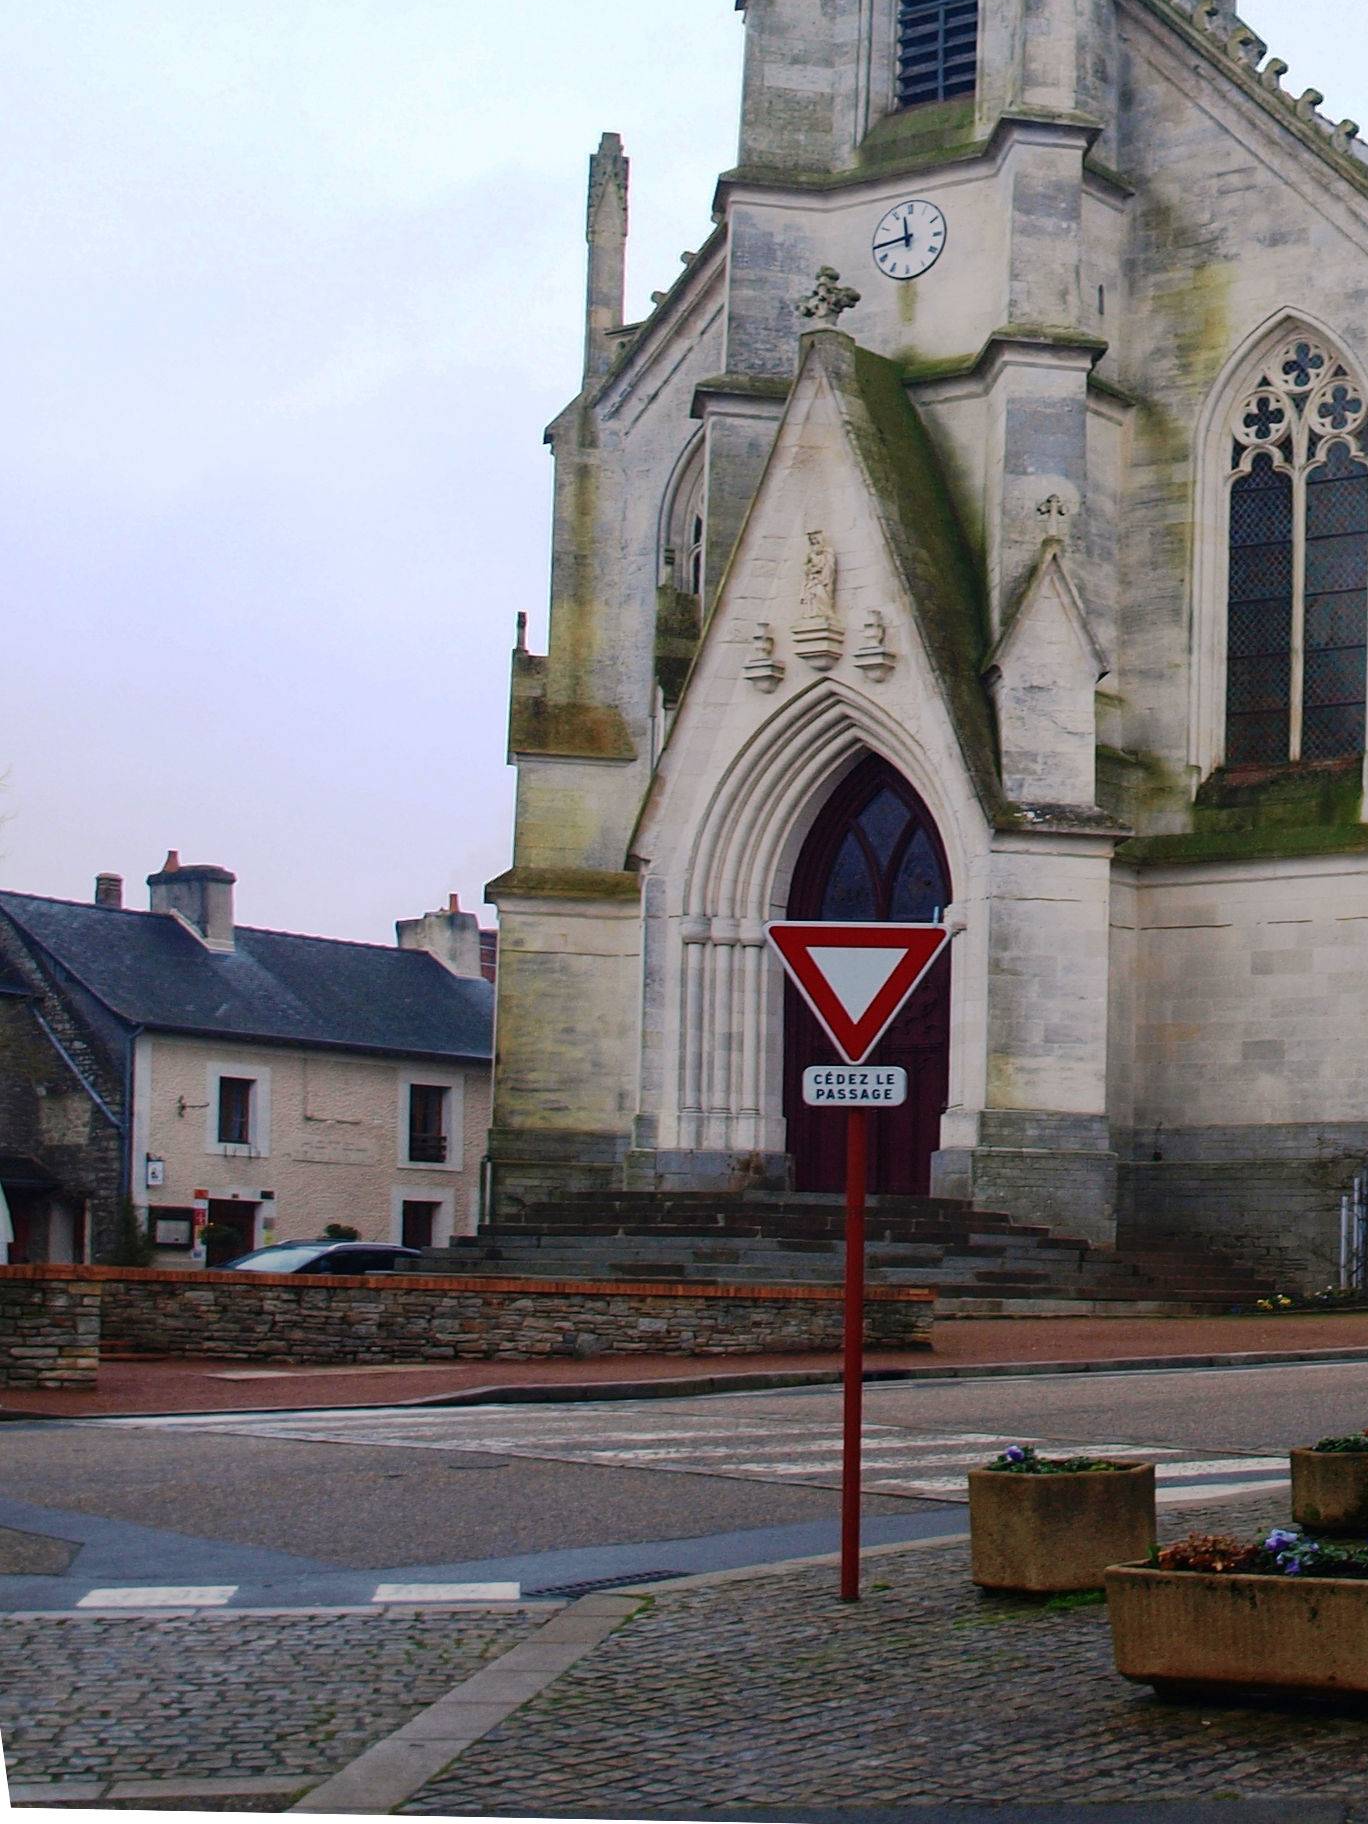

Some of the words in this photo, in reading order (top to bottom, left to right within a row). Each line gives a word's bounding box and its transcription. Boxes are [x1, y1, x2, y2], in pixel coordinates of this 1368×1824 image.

[814, 1072, 868, 1085] CÉDEZ
[877, 1074, 895, 1085] LE
[816, 1089, 892, 1100] PASSAGE
